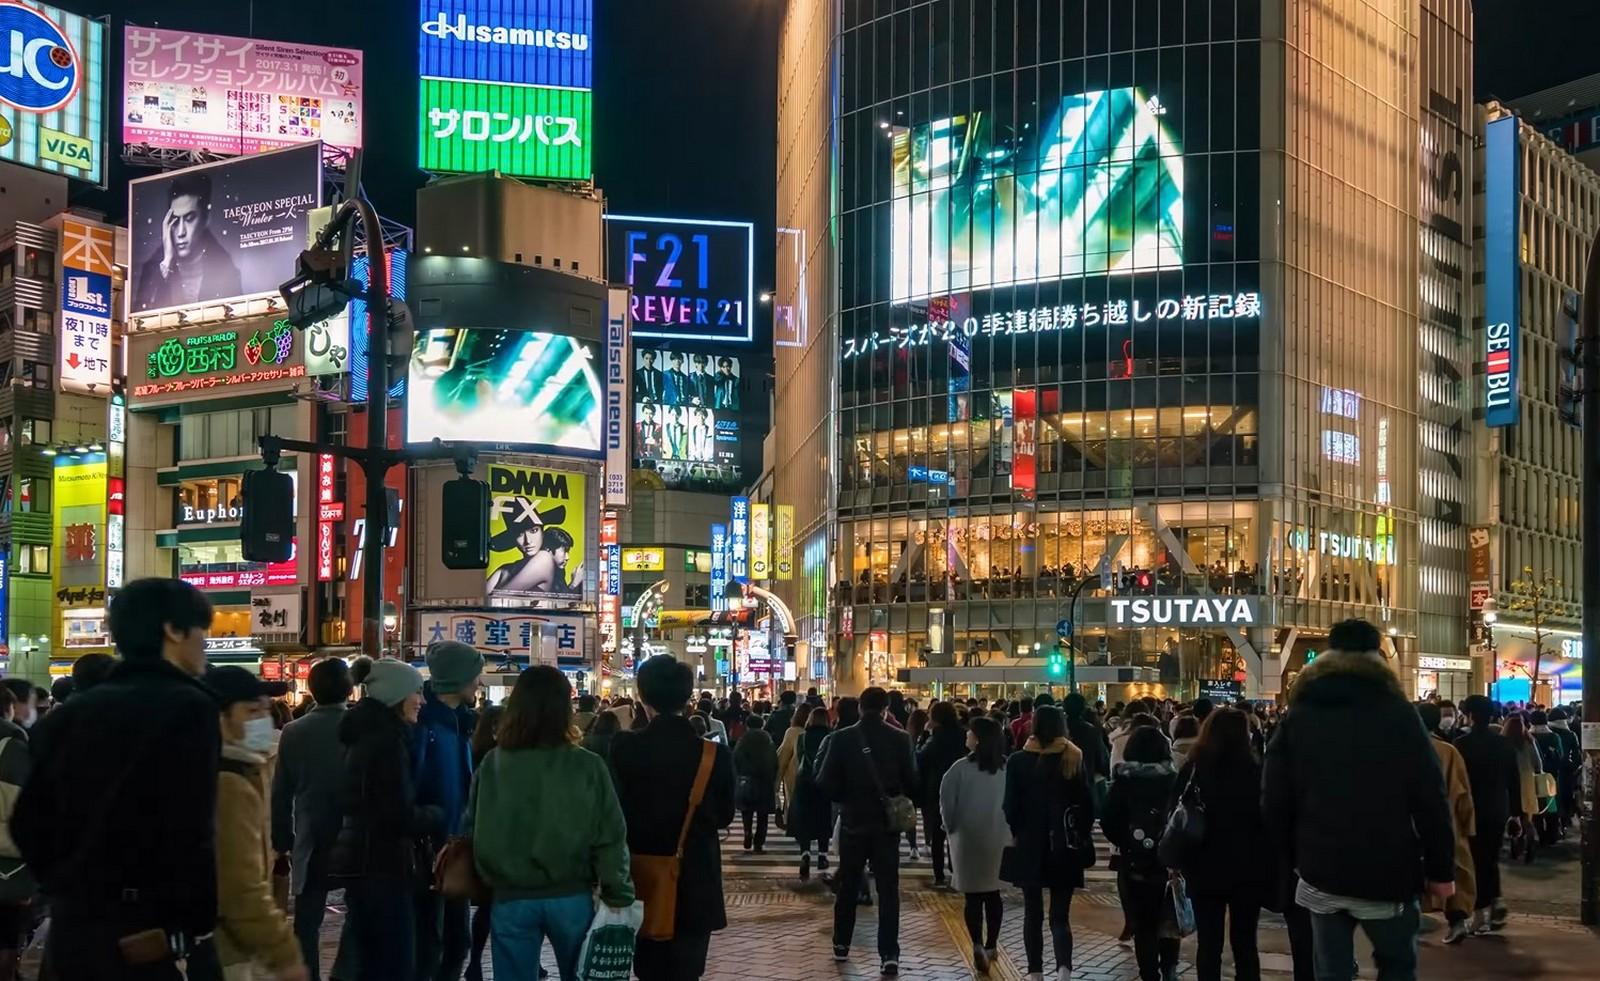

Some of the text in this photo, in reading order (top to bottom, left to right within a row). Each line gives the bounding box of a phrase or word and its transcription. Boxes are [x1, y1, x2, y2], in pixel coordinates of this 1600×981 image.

[421, 13, 588, 50] Hisamitsu
[128, 29, 254, 69] サイサイ
[255, 59, 299, 71] 2017.3.1
[428, 108, 581, 147] サロンパス
[46, 139, 90, 162] VISA
[223, 193, 314, 219] TAECYEON SPECIAL
[626, 231, 708, 289] F21
[717, 299, 742, 325] 21
[74, 334, 100, 350] まで
[84, 356, 108, 372] 地下
[187, 343, 235, 373] 西村
[609, 312, 624, 449] Taisei neon
[491, 467, 569, 500] DMM
[490, 496, 543, 525] FX
[734, 501, 747, 577] 洋服の青山
[1111, 599, 1253, 623] TSUTAYA
